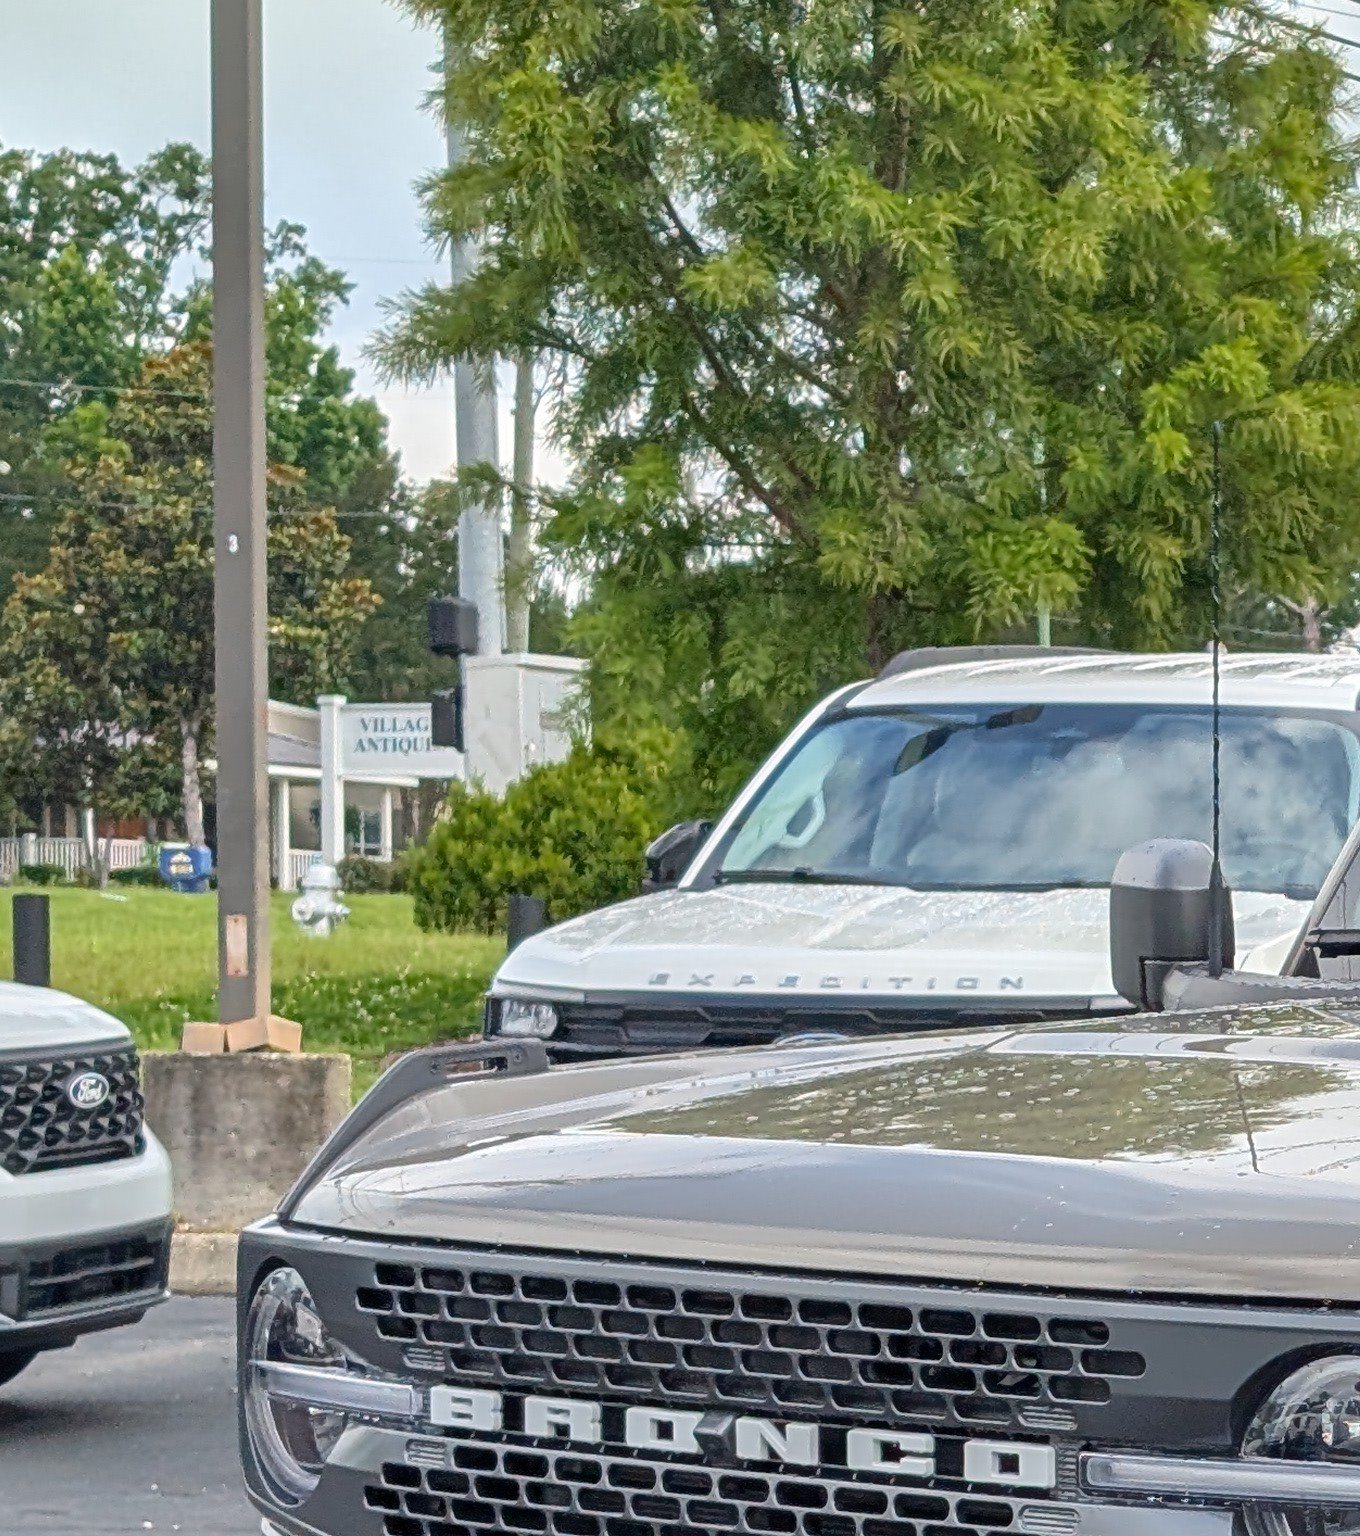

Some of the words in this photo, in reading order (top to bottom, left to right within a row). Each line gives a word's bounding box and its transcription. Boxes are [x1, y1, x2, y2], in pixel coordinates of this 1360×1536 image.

[360, 716, 429, 732] VILLAG
[354, 738, 436, 756] ANTIQU
[649, 973, 1023, 990] EXPEDITION
[430, 1384, 1056, 1489] BRONCO
